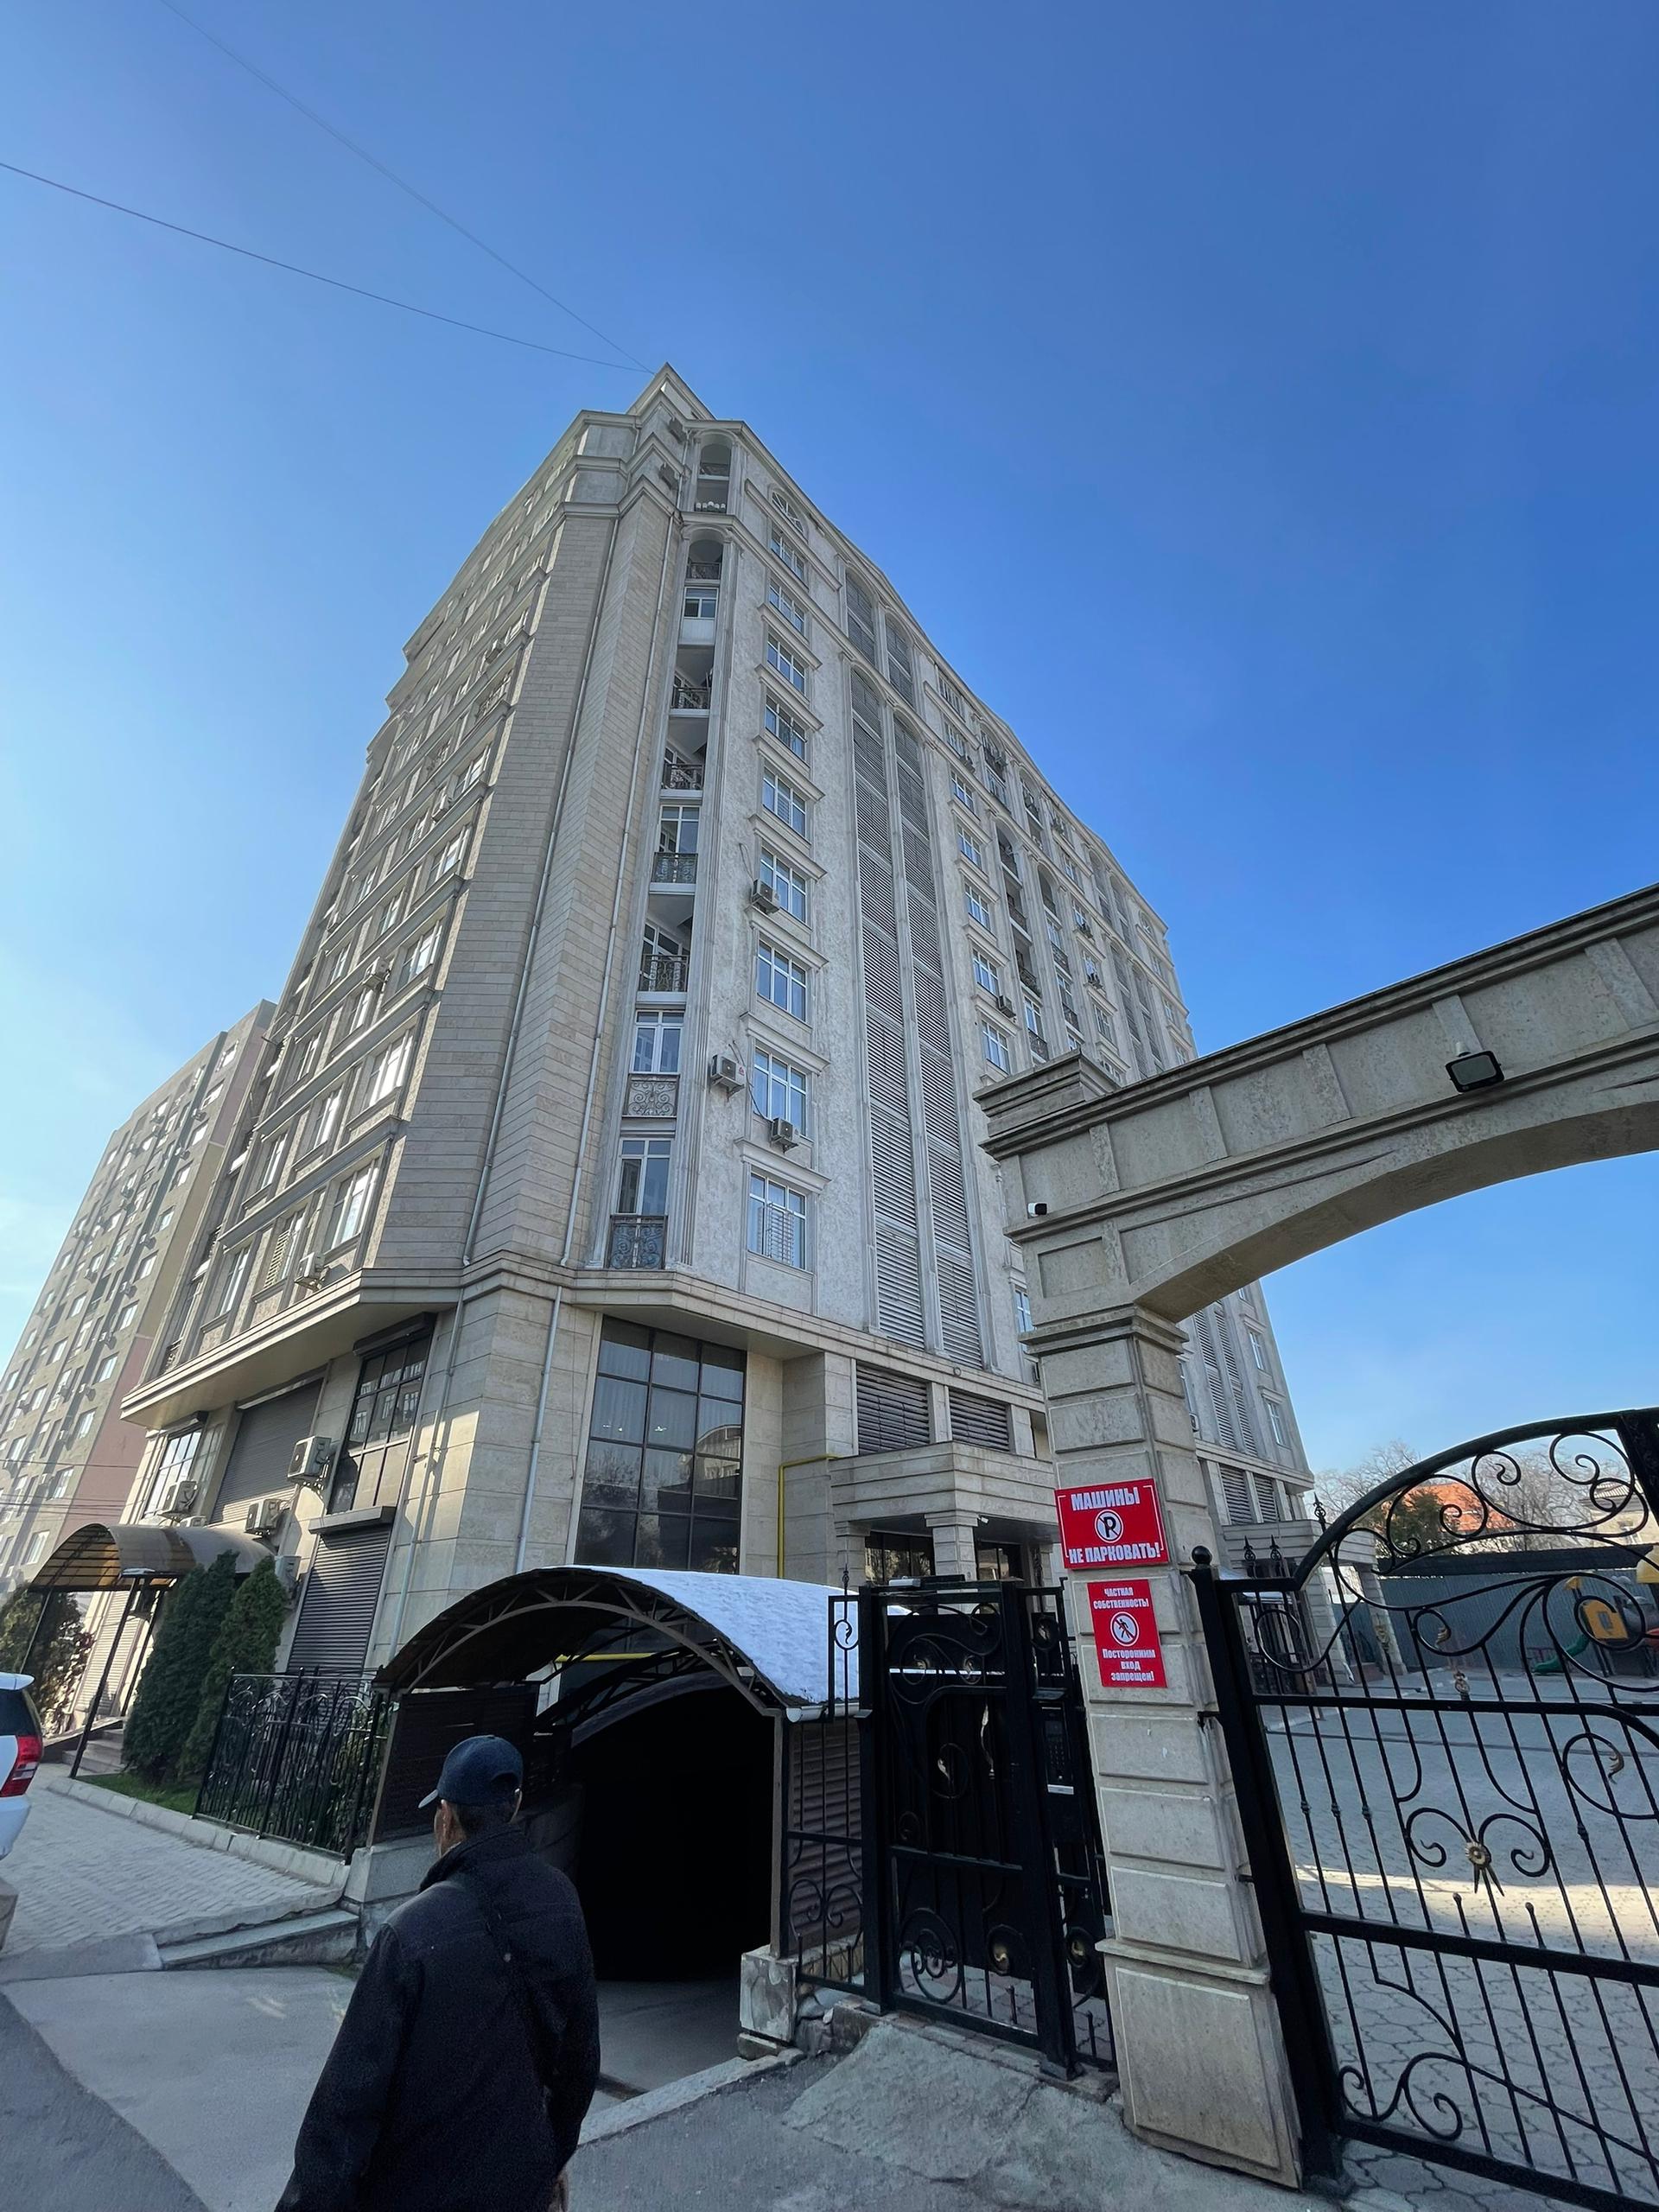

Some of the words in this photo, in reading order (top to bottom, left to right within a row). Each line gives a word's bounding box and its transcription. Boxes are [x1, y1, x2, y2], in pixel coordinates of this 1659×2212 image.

[1071, 1486, 1141, 1511] МАШИНЫ
[1068, 1548, 1084, 1564] НЕ
[1084, 1541, 1161, 1563] ПАРКОВАТЬ!
[1103, 1586, 1134, 1598] ЧАСТНАЯ
[1102, 1649, 1156, 1659] Посторонним
[1110, 1670, 1155, 1682] запрещен!
